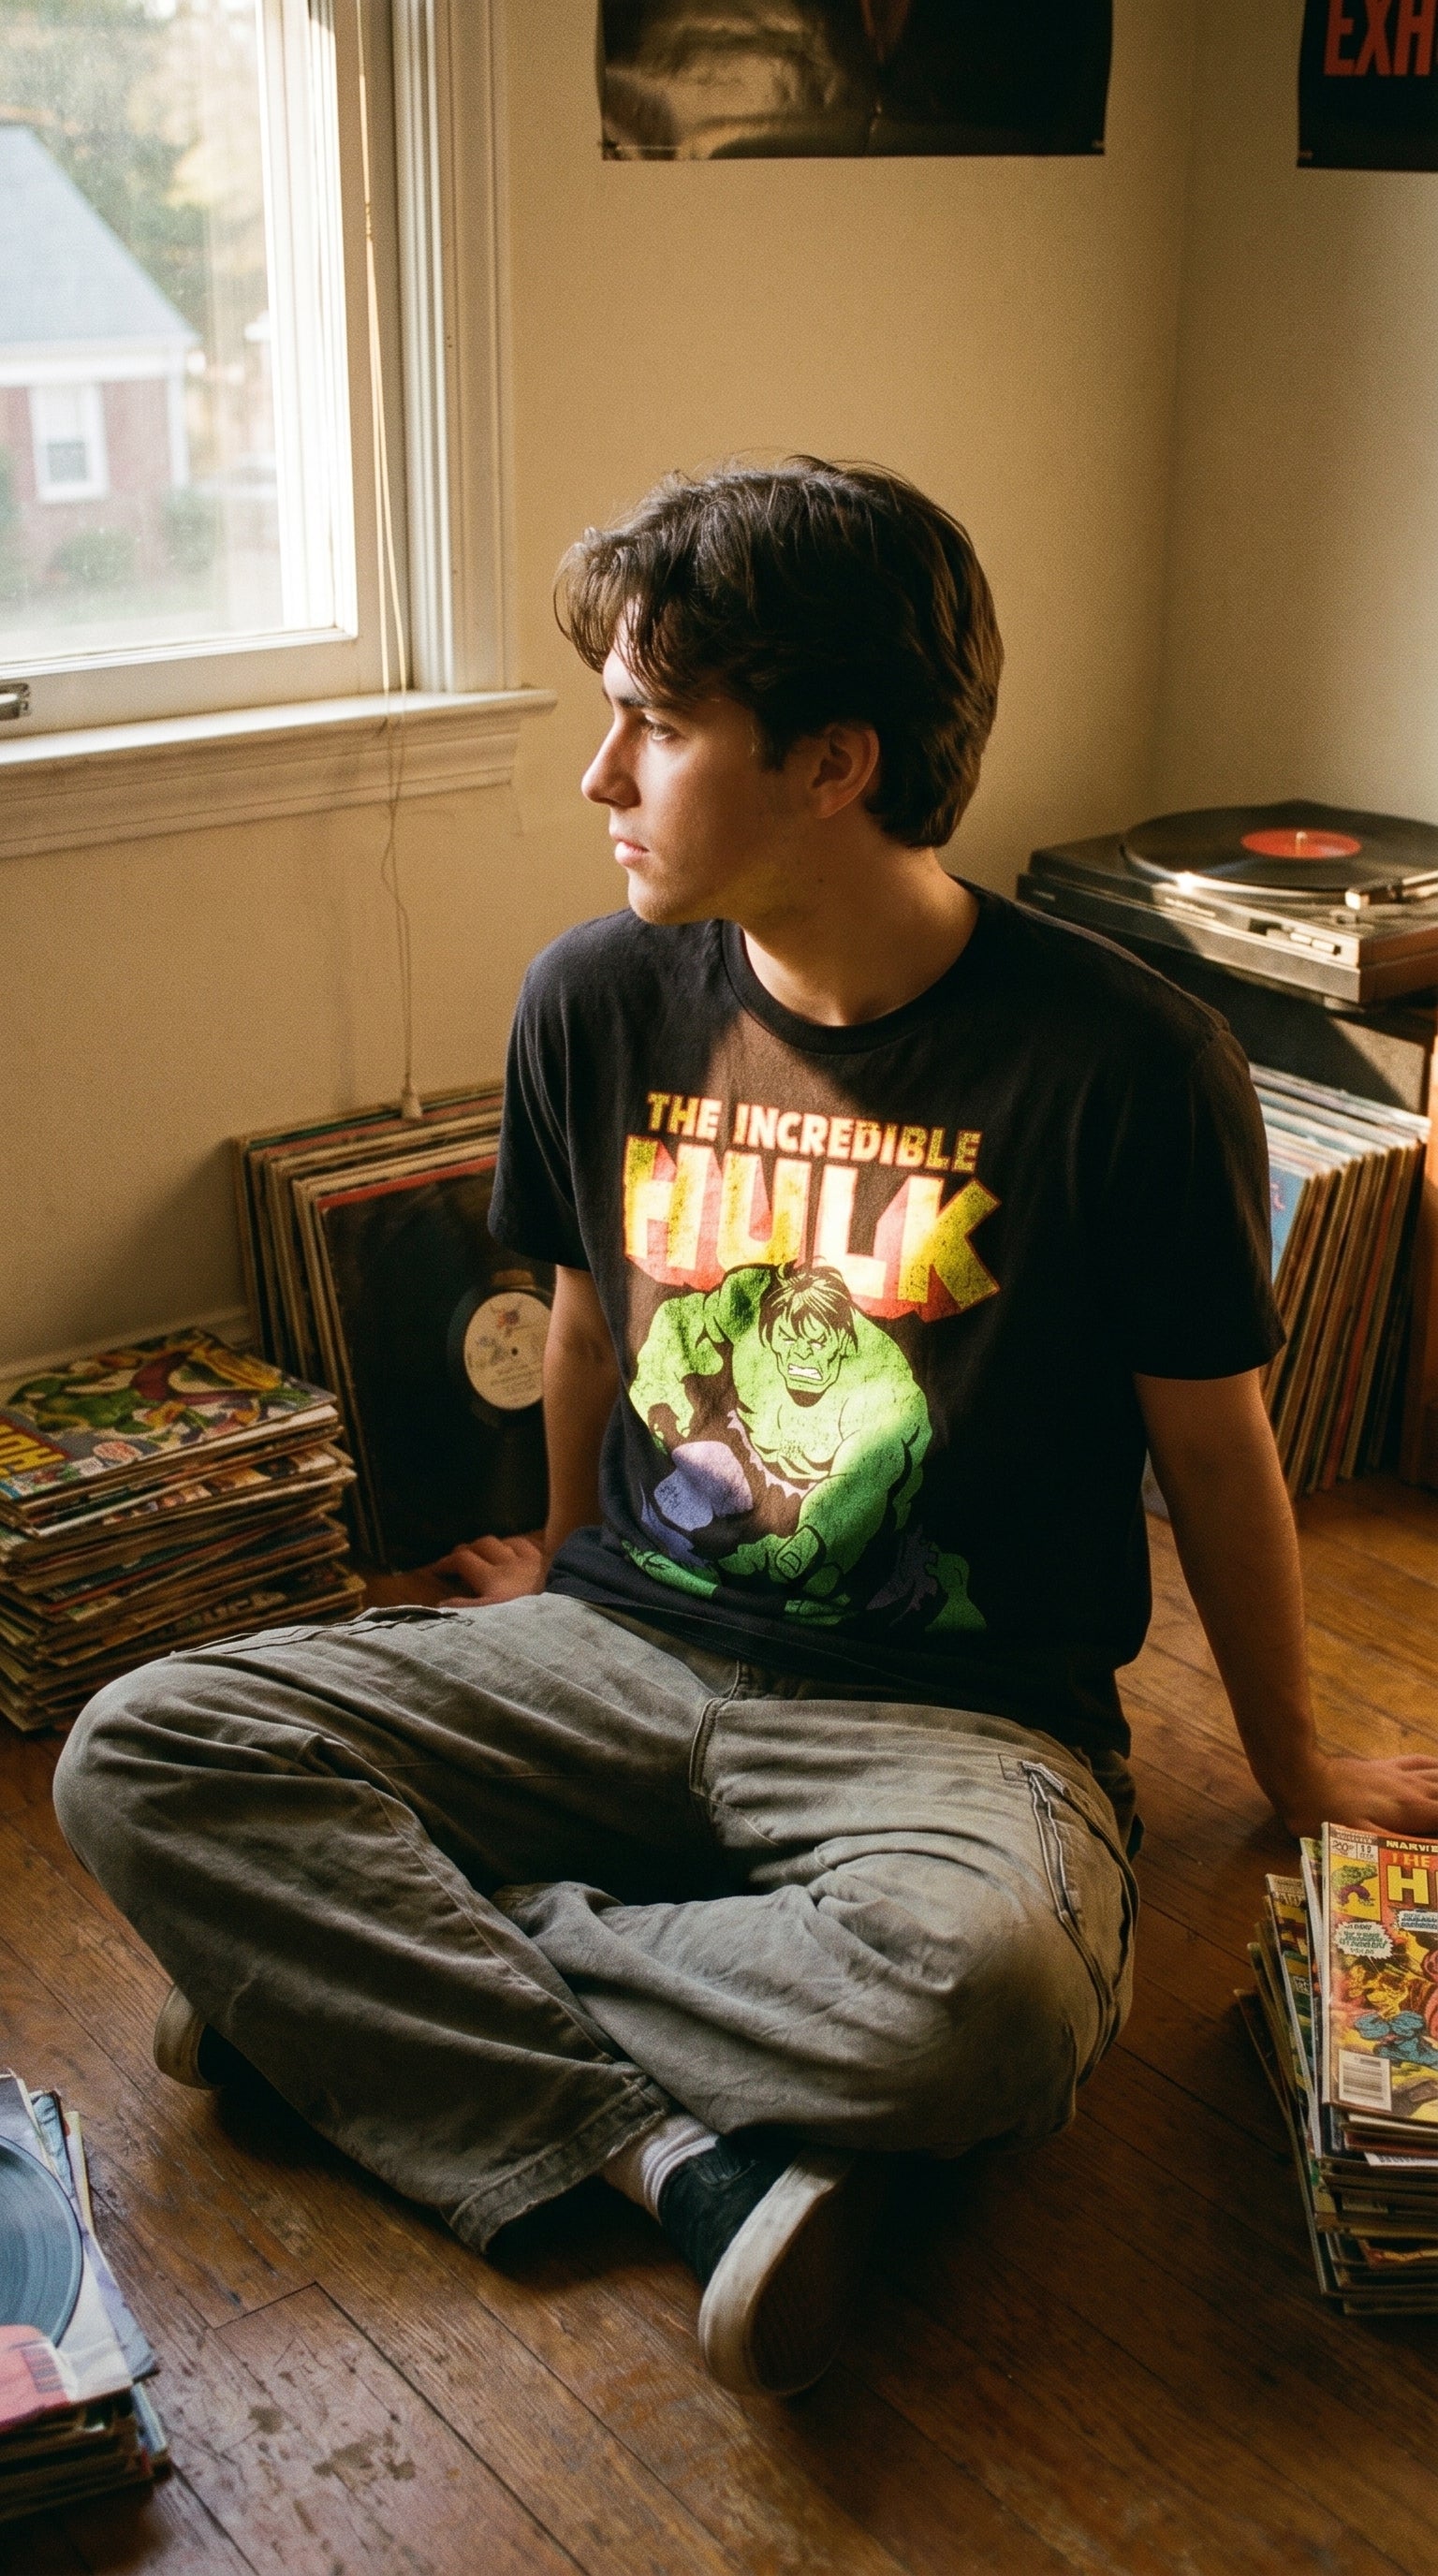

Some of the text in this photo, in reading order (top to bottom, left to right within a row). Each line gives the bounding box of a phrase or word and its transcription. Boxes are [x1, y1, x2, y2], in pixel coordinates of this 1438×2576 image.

[1322, 0, 1438, 77] EXH
[647, 1091, 983, 1175] THE INCREDIBLE
[624, 1134, 1002, 1322] HULK
[1387, 1865, 1438, 1905] H
